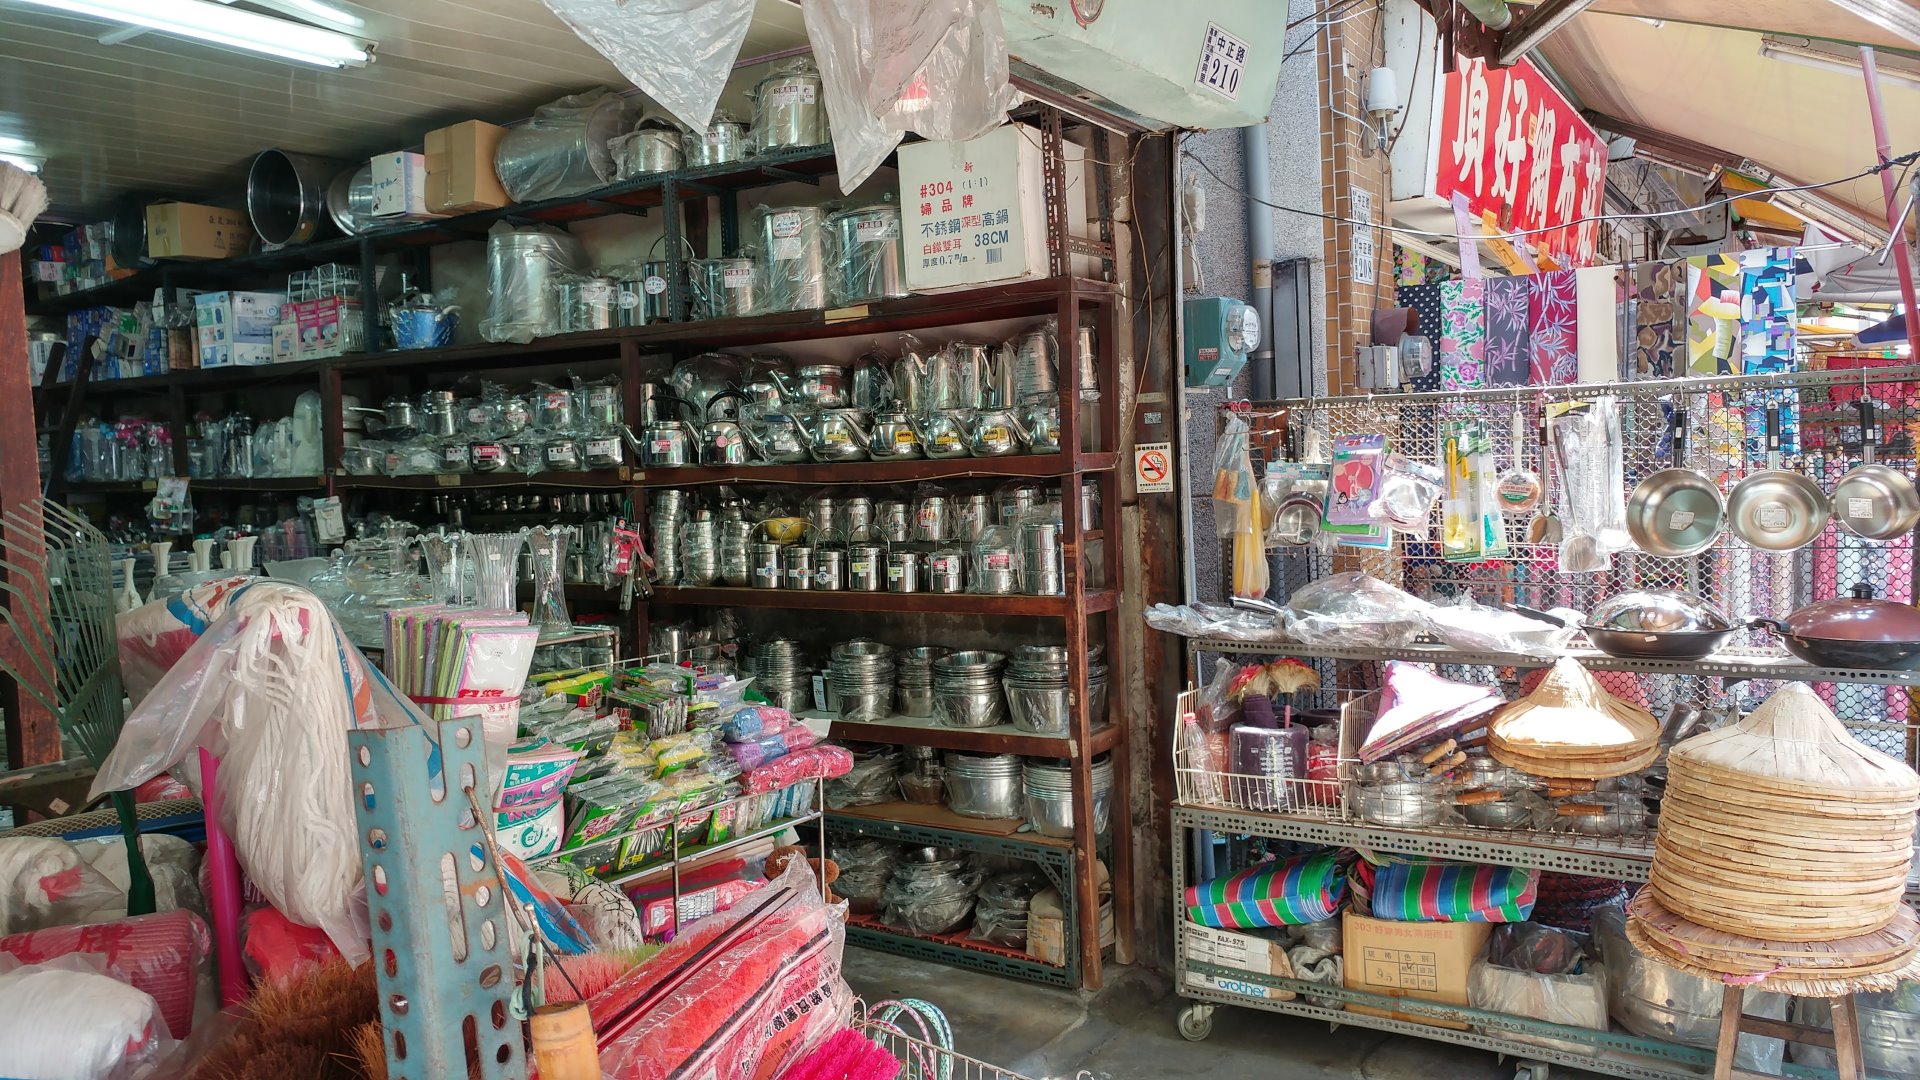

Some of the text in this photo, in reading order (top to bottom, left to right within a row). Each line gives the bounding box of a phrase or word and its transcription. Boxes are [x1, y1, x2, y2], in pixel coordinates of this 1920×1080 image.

[1217, 35, 1246, 63] 中正路
[1209, 58, 1239, 94] 210
[963, 161, 974, 173] 新
[919, 180, 954, 198] #304
[974, 229, 1010, 248] 38CM
[1358, 257, 1372, 280] 208
